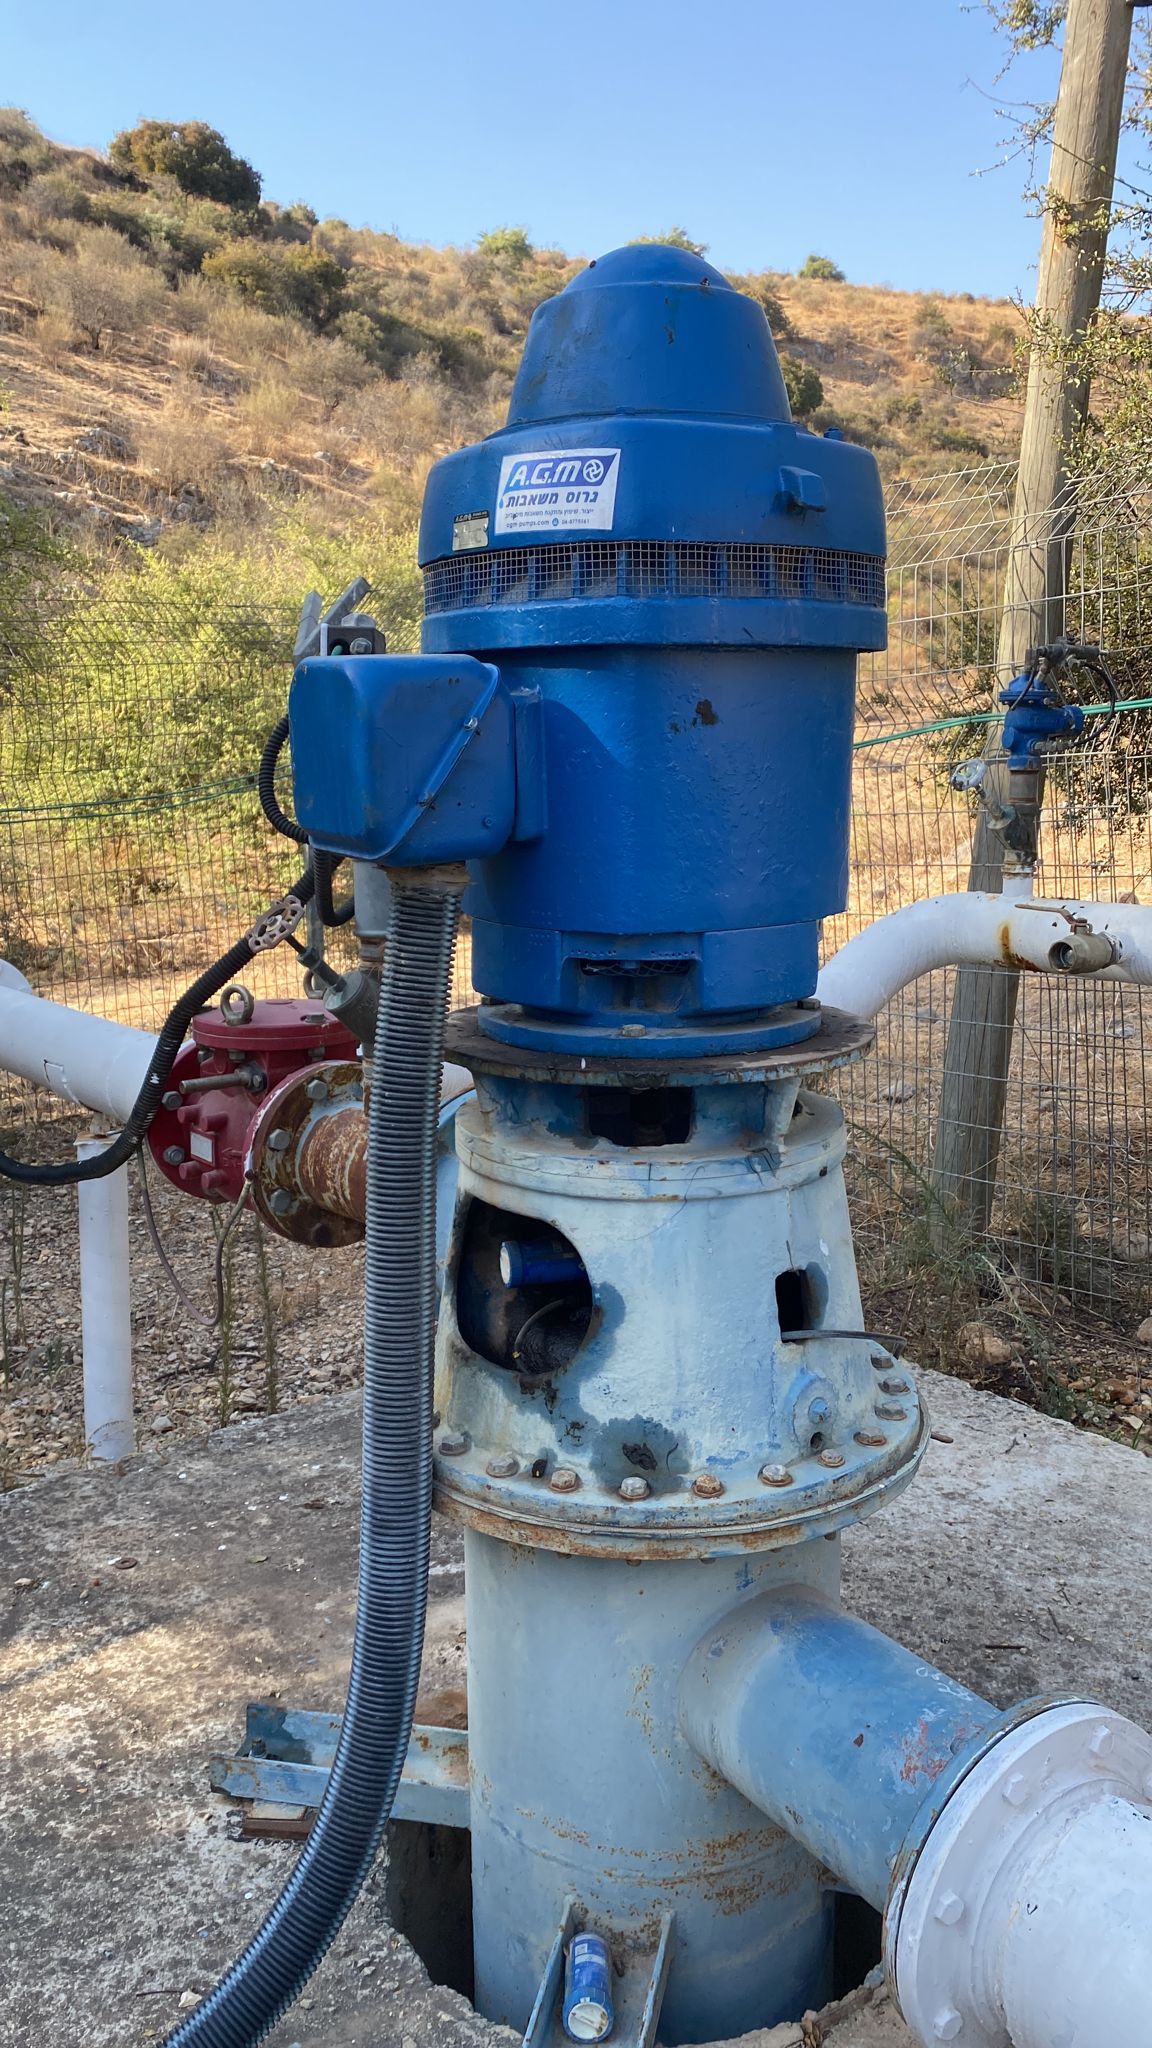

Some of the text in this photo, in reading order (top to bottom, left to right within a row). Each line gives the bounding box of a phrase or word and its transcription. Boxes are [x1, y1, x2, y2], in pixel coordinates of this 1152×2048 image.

[509, 460, 582, 487] A.G.M
[506, 491, 599, 508] גרוס משאבות
